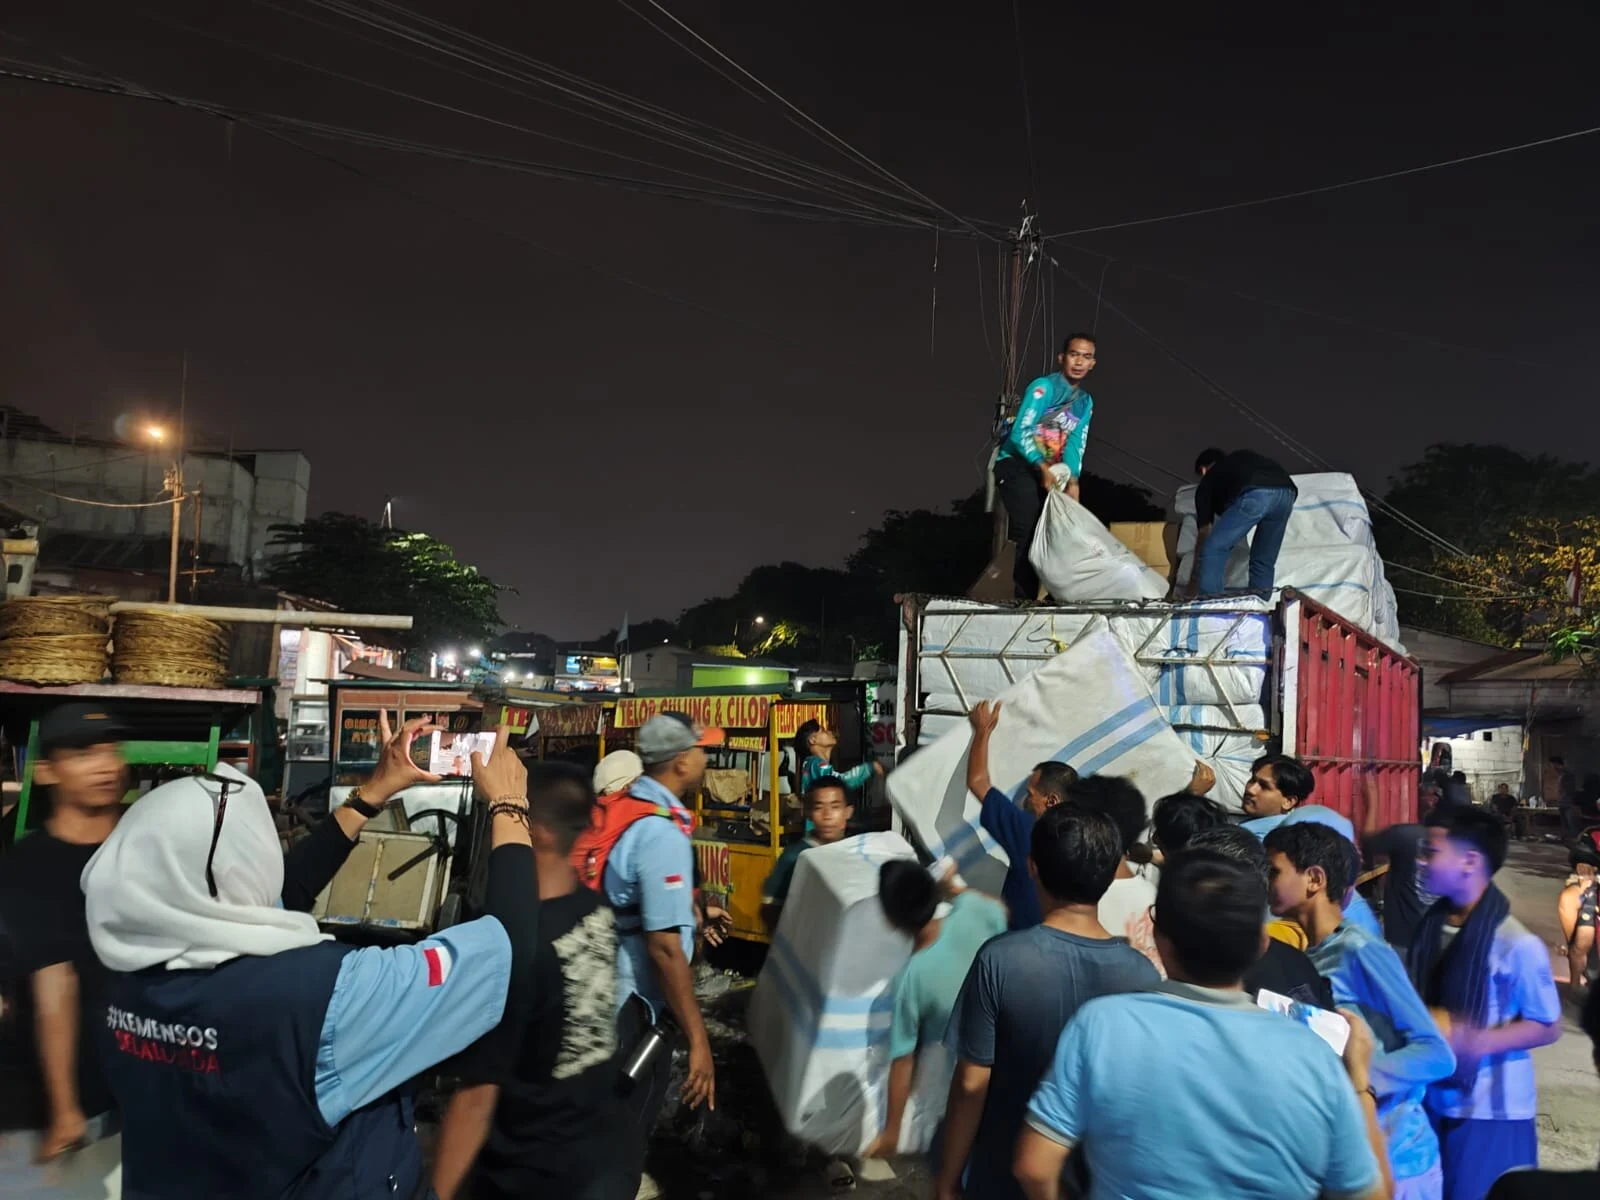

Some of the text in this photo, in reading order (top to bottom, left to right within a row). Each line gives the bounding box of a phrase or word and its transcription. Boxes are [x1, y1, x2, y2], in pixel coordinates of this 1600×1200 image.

[714, 698, 722, 726] &
[726, 696, 768, 727] CILOR
[871, 700, 894, 716] Teh
[106, 1004, 218, 1050] #KEMENSOS
